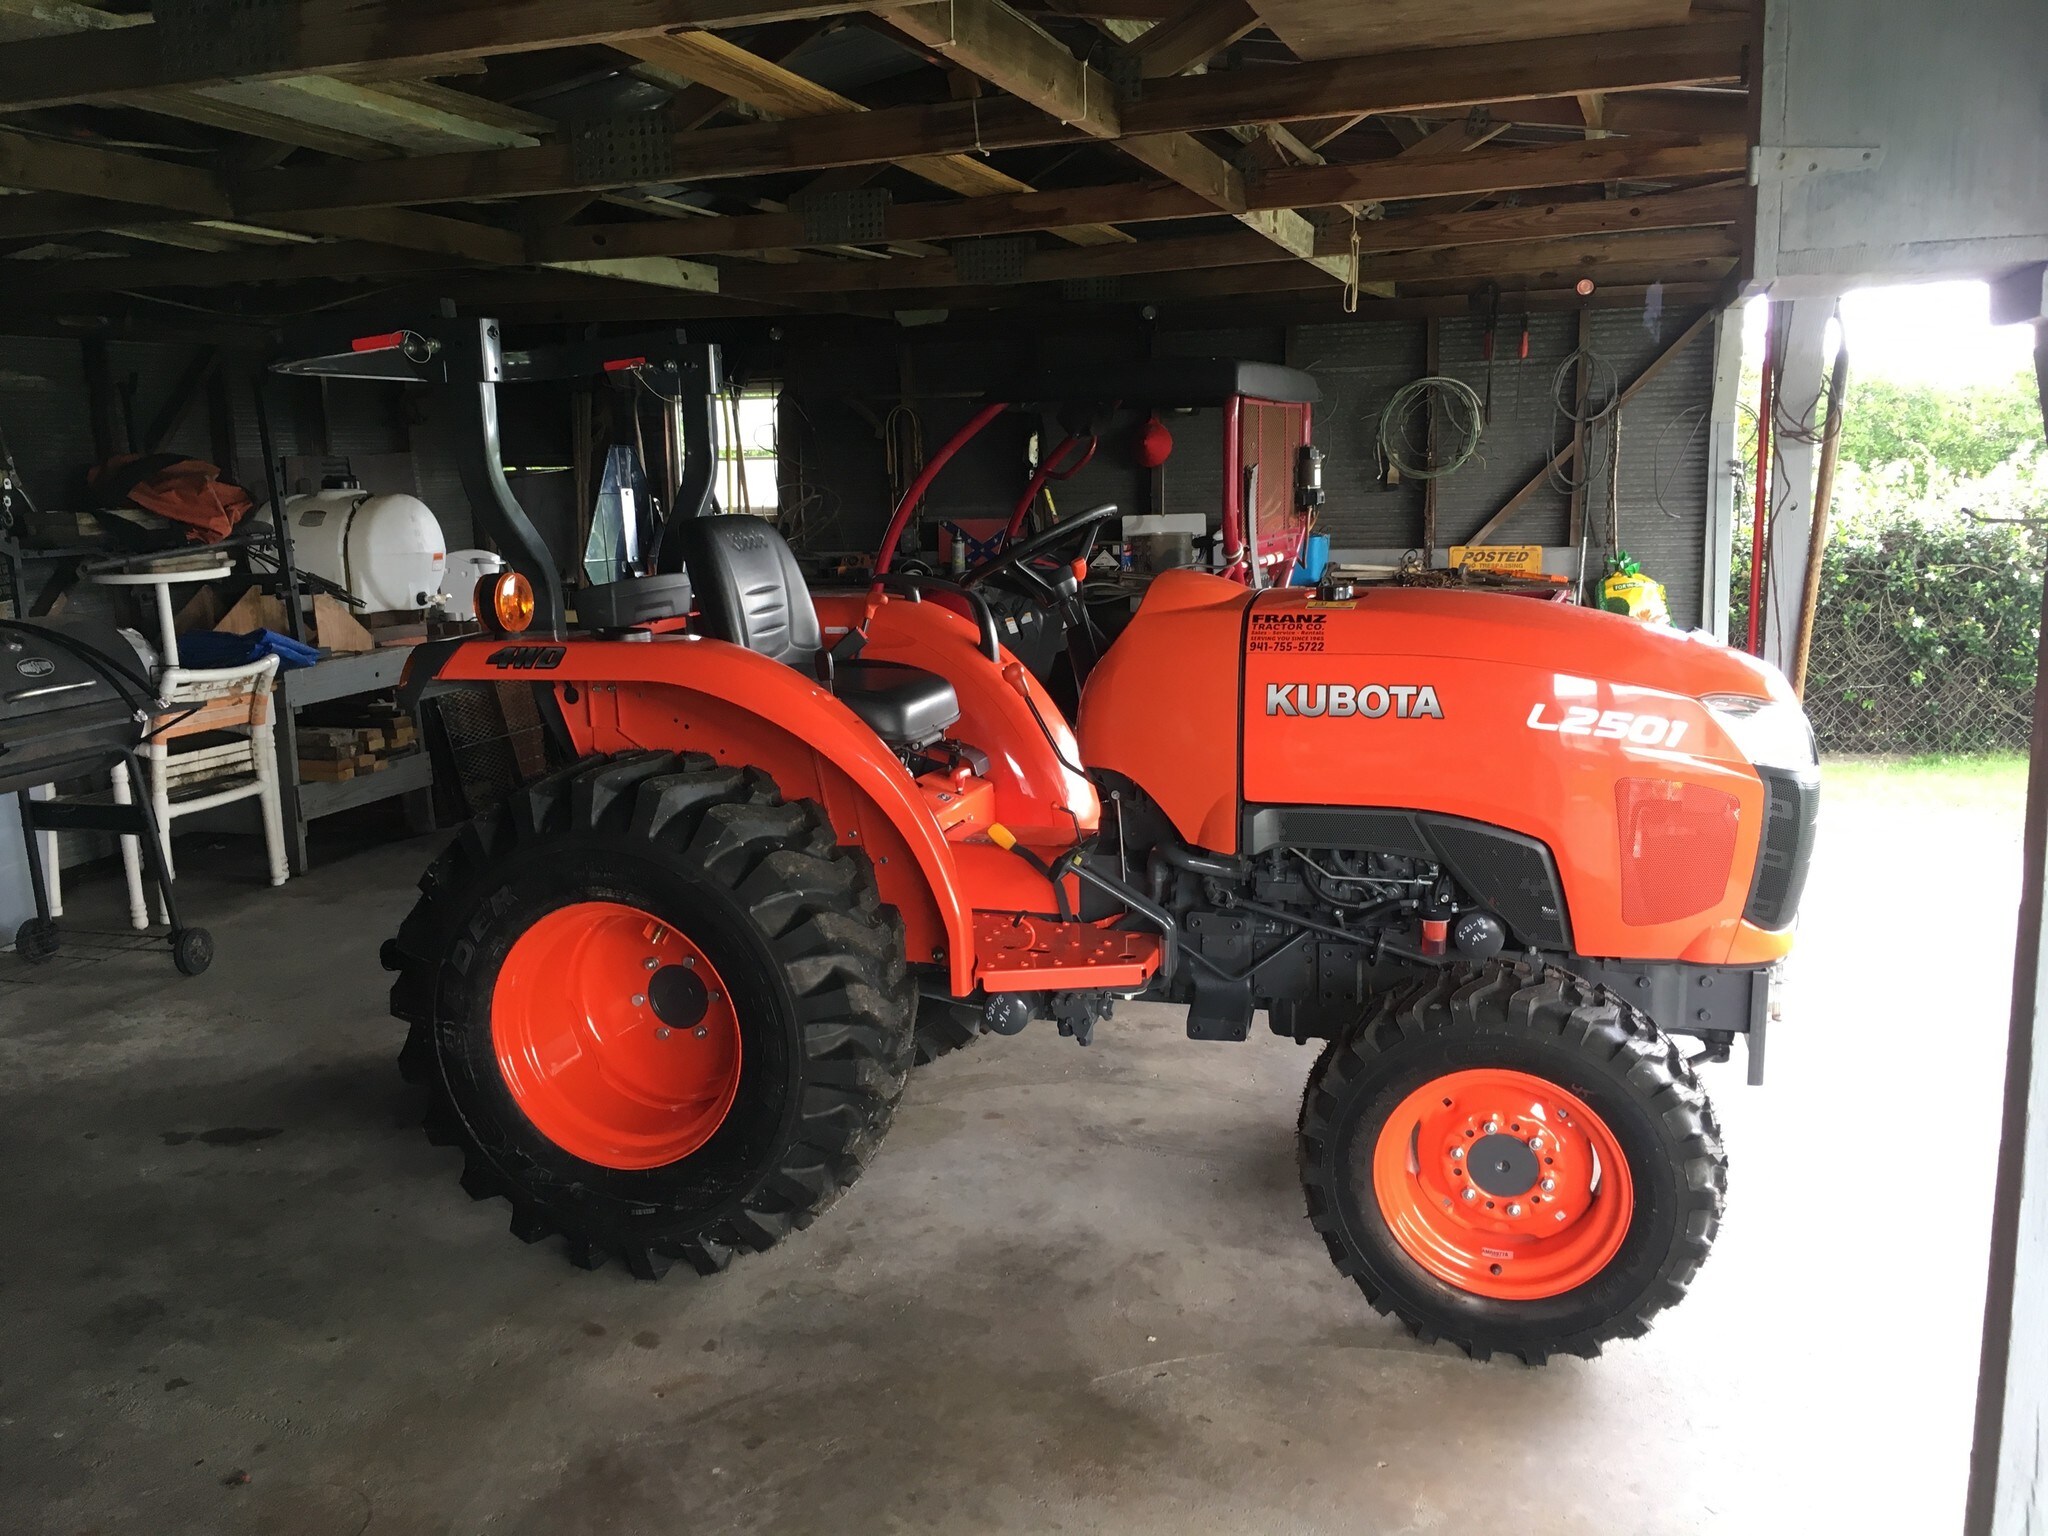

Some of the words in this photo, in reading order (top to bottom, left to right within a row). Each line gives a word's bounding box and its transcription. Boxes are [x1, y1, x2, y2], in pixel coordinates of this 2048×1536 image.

[1462, 551, 1529, 562] POSTED
[1252, 614, 1327, 623] FRANZ
[1250, 641, 1325, 651] 941-755-5722
[485, 646, 567, 669] 4WD
[1266, 683, 1445, 719] KUBOTA
[1526, 702, 1689, 748] L2501
